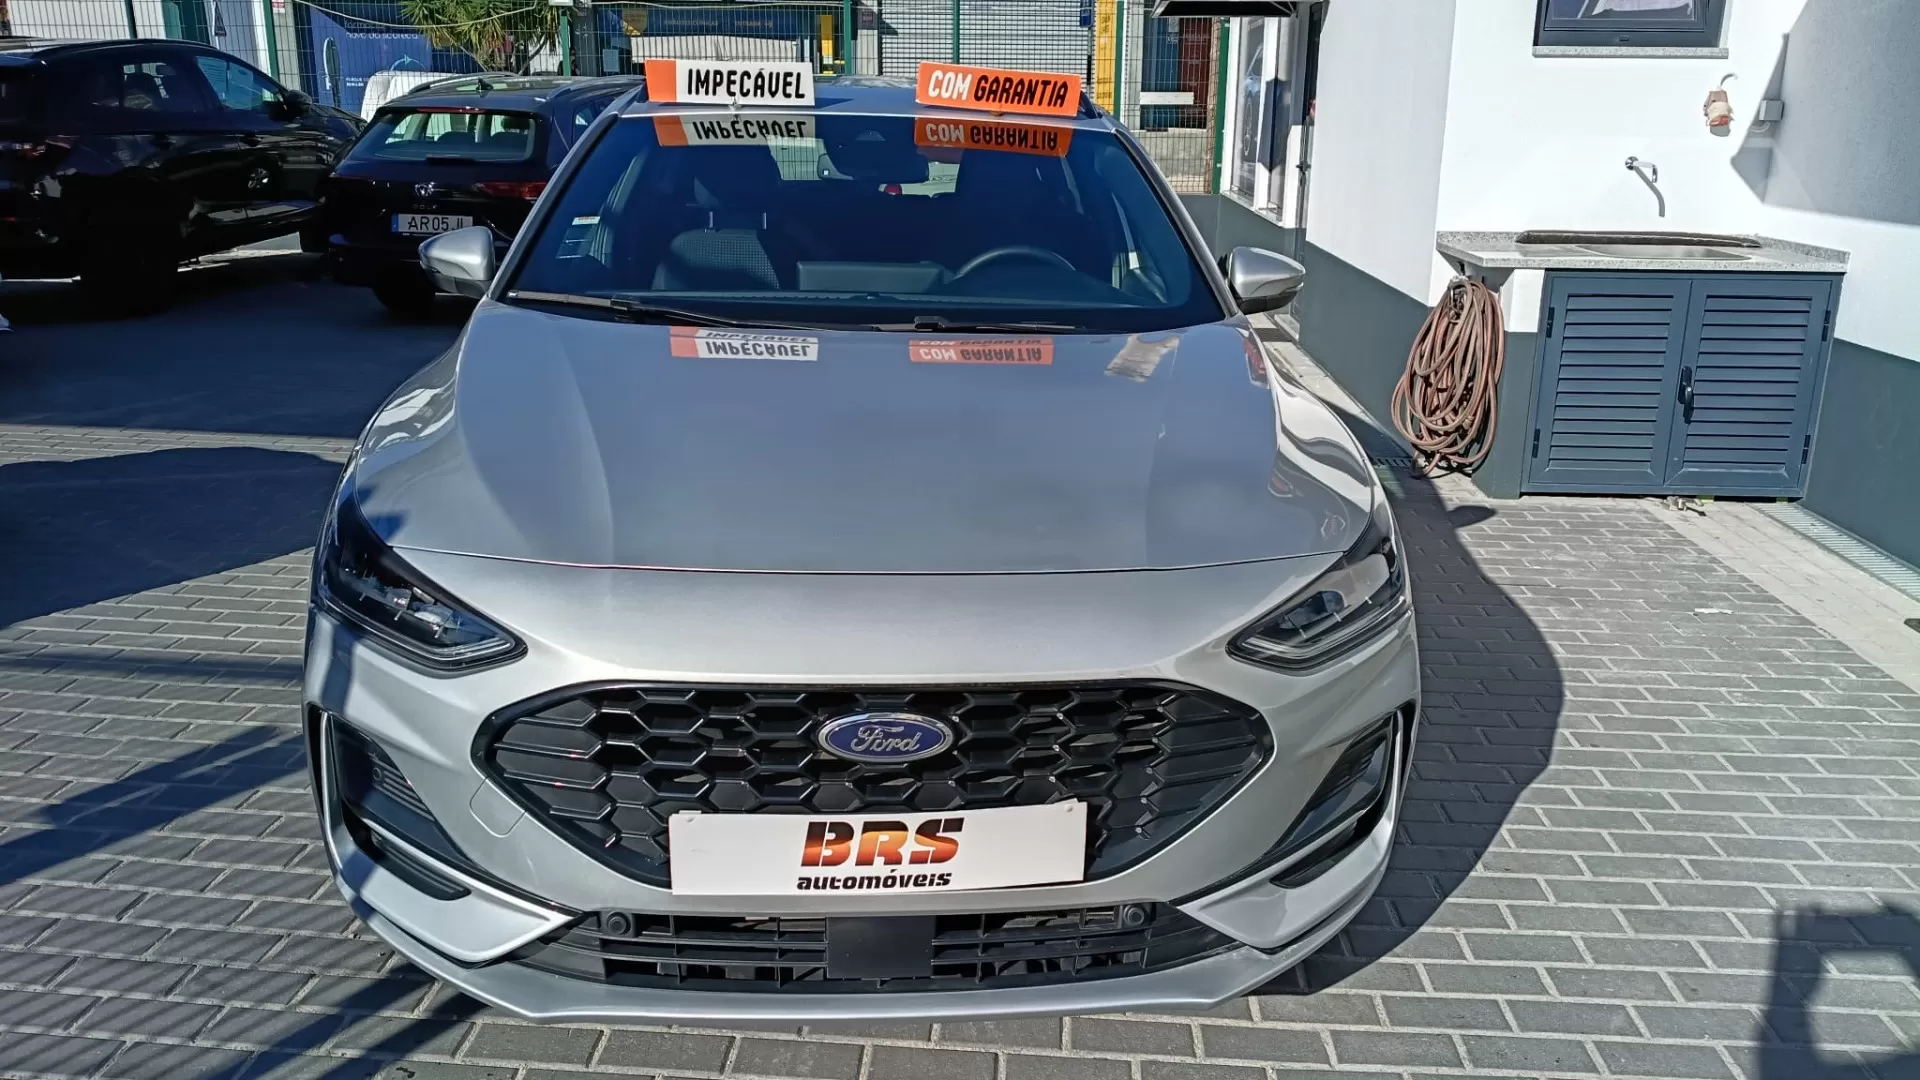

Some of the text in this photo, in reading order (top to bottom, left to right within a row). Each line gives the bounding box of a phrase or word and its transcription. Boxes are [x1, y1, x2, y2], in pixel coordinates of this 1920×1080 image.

[687, 68, 806, 99] IMPECÁVEL
[928, 69, 1069, 108] COM GARANTIA
[407, 216, 430, 231] AR
[432, 217, 449, 231] 05
[850, 725, 921, 752] Ford
[801, 817, 965, 867] BRS
[796, 869, 953, 890] automóveis
